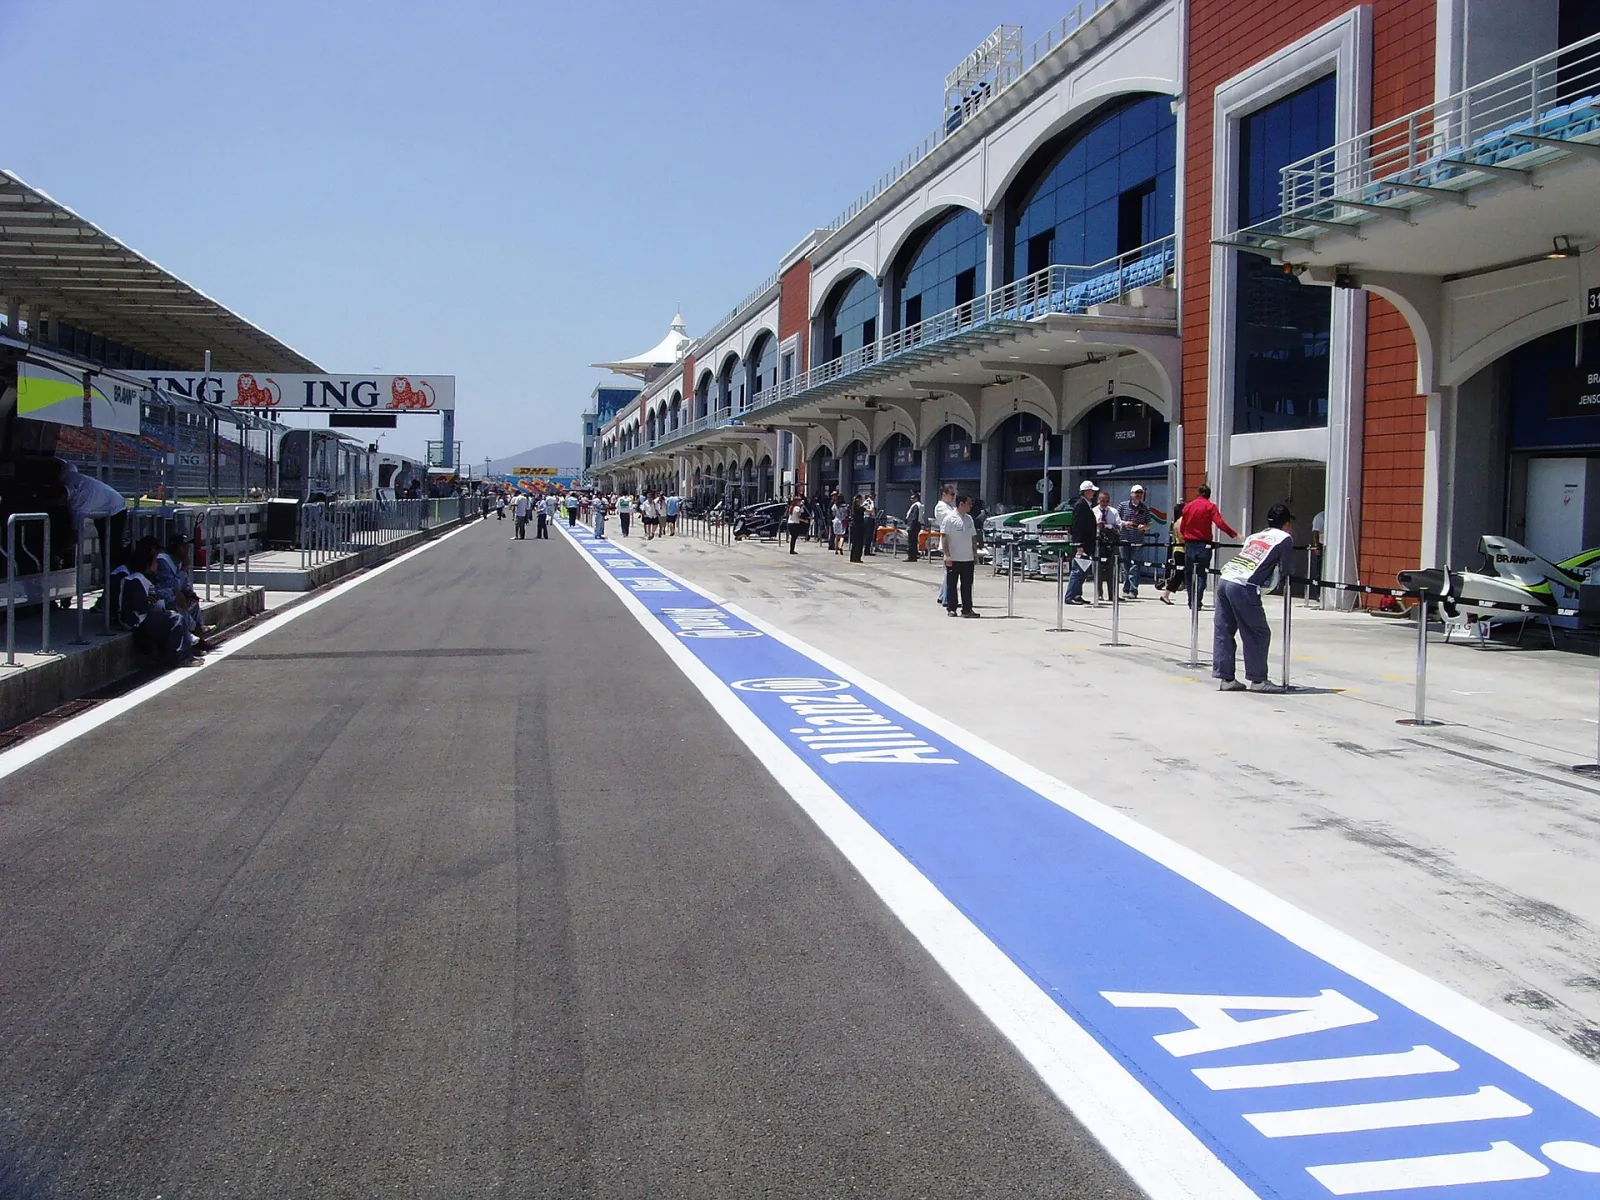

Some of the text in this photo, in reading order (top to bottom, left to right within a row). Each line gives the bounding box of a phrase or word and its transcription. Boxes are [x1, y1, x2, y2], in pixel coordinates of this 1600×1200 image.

[148, 377, 226, 405] ING
[303, 380, 380, 408] ING
[178, 454, 200, 466] NG
[520, 467, 550, 475] DHL
[778, 694, 960, 765] Allianz
